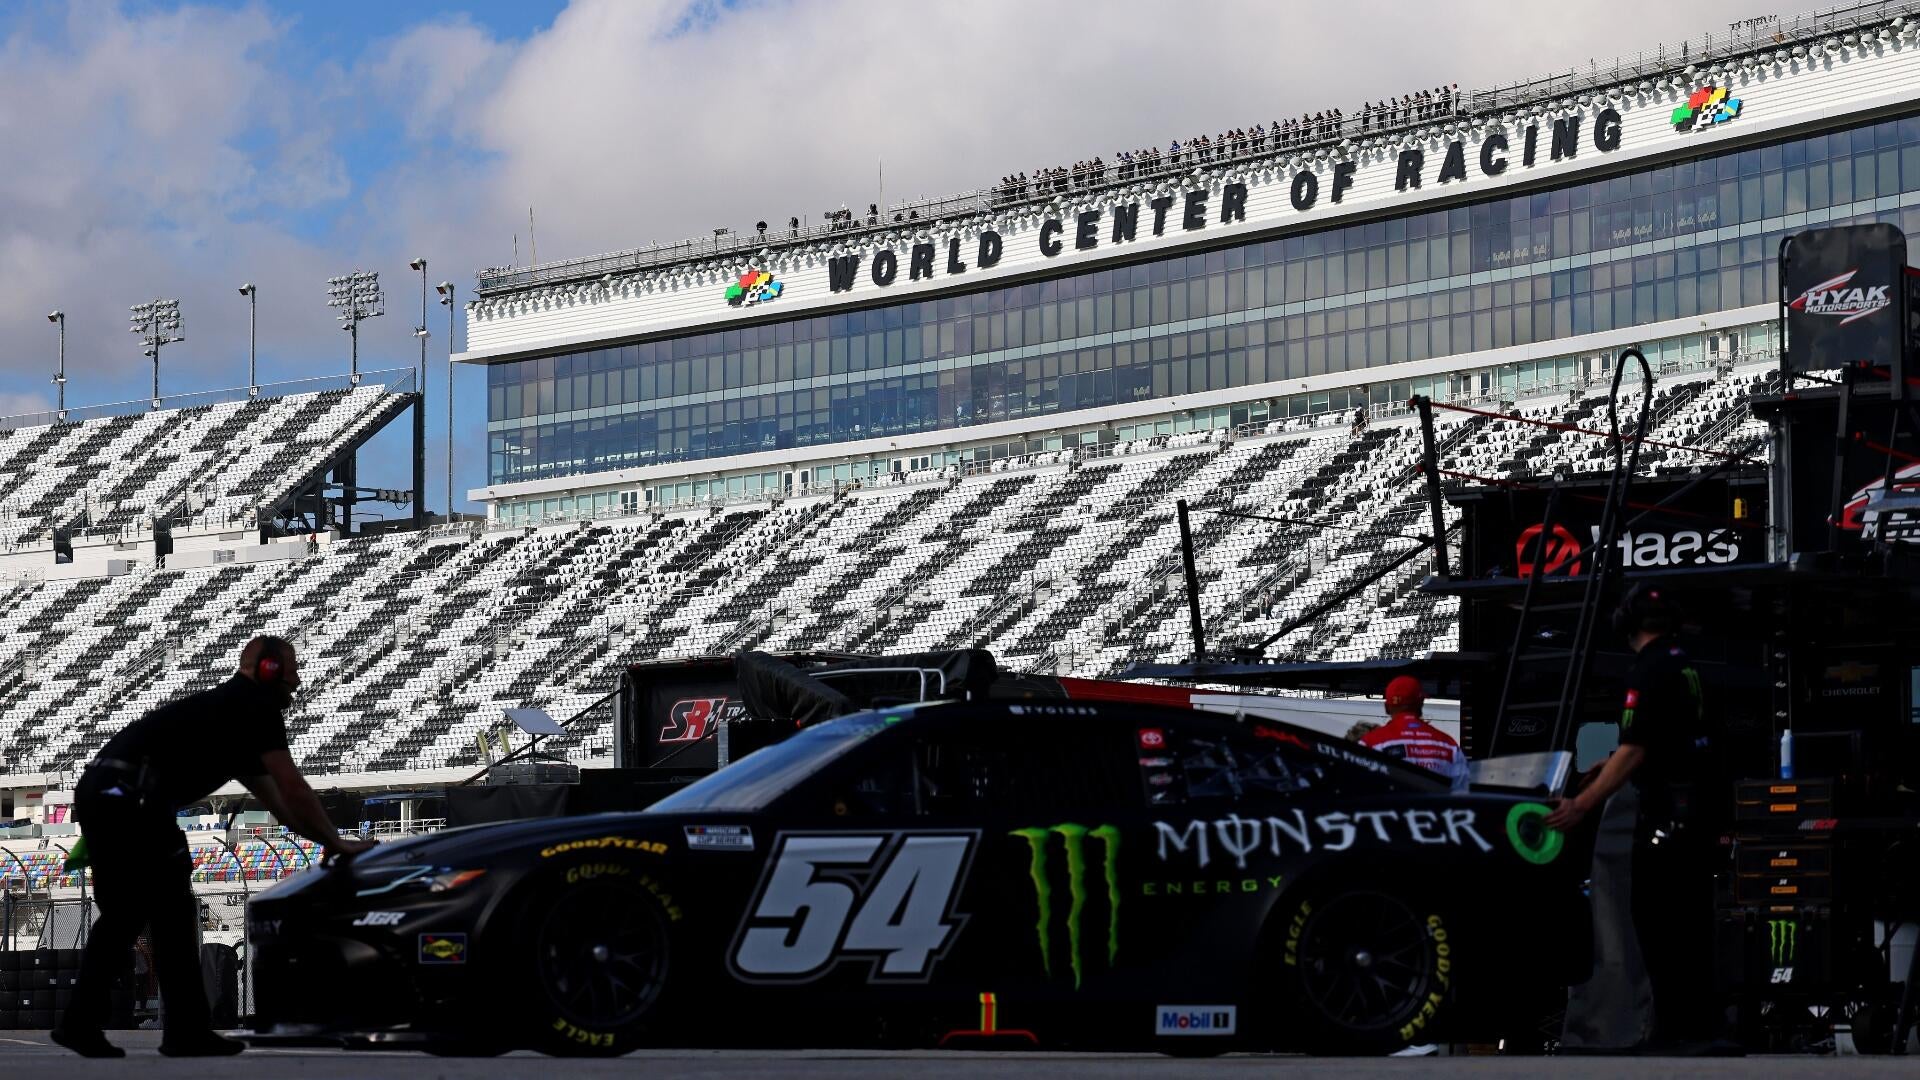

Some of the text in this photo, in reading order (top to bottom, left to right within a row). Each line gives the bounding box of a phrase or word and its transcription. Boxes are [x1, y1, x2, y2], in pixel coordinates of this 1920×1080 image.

[828, 108, 1622, 292] WORLD CENTER OF RACING
[1805, 285, 1890, 307] HYAK
[1805, 299, 1886, 313] MOTORSPORTS
[1821, 687, 1881, 697] CHEVROLET
[539, 835, 669, 857] GOODYEAR
[1152, 807, 1494, 870] MONSTER
[1142, 875, 1282, 896] ENERGY
[727, 829, 981, 983] 54
[352, 911, 406, 926] JGR
[1283, 899, 1312, 967] EAGLE
[1770, 967, 1794, 984] 54
[1162, 1012, 1210, 1029] Mobil
[551, 1017, 616, 1047] EAGLE
